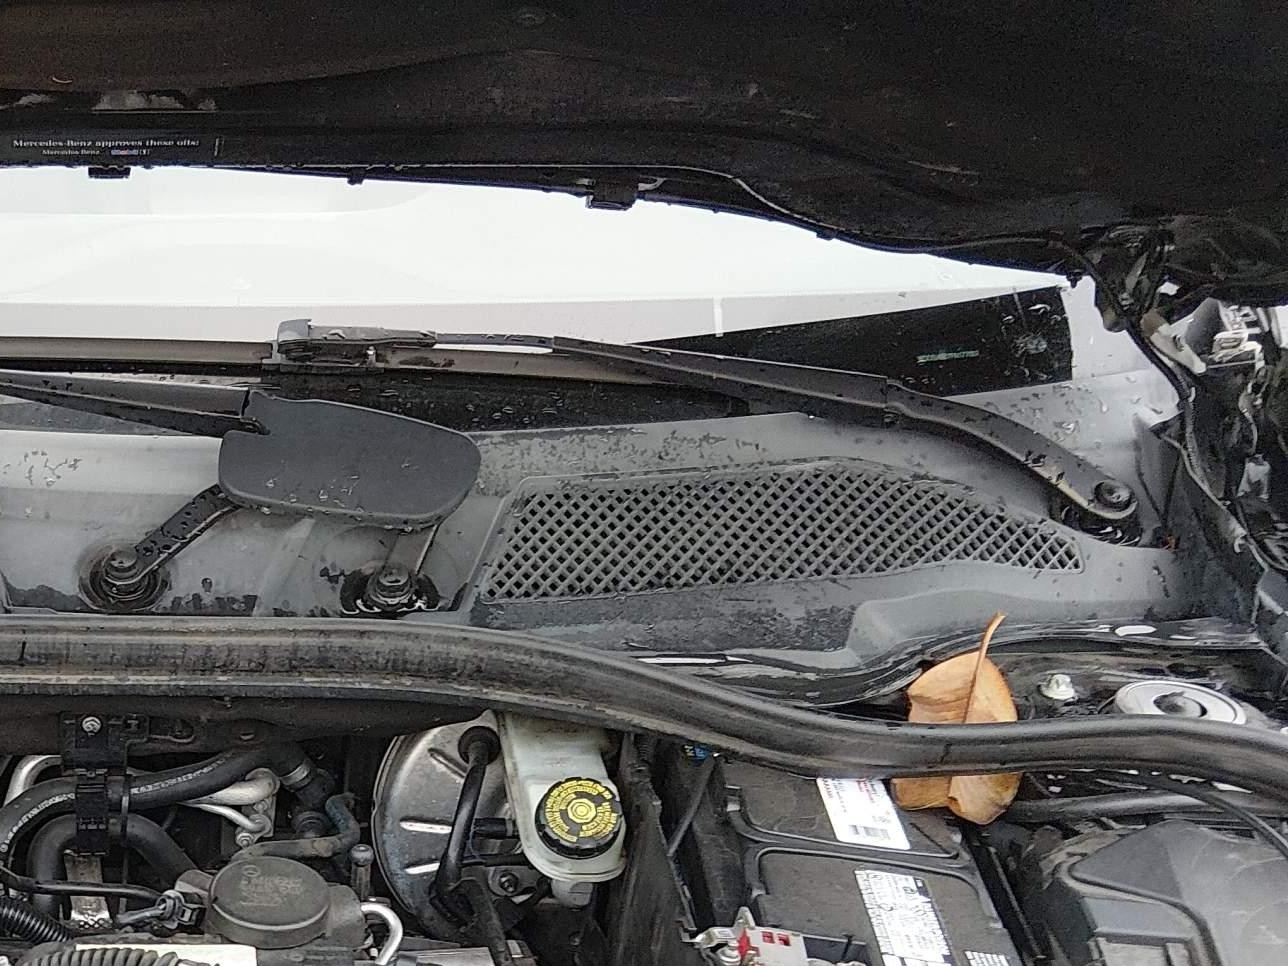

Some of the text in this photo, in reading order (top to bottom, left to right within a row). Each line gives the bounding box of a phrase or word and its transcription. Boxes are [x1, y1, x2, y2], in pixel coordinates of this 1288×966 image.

[13, 139, 92, 147] Mercedes-Benz
[95, 140, 143, 148] approves
[146, 139, 174, 147] these
